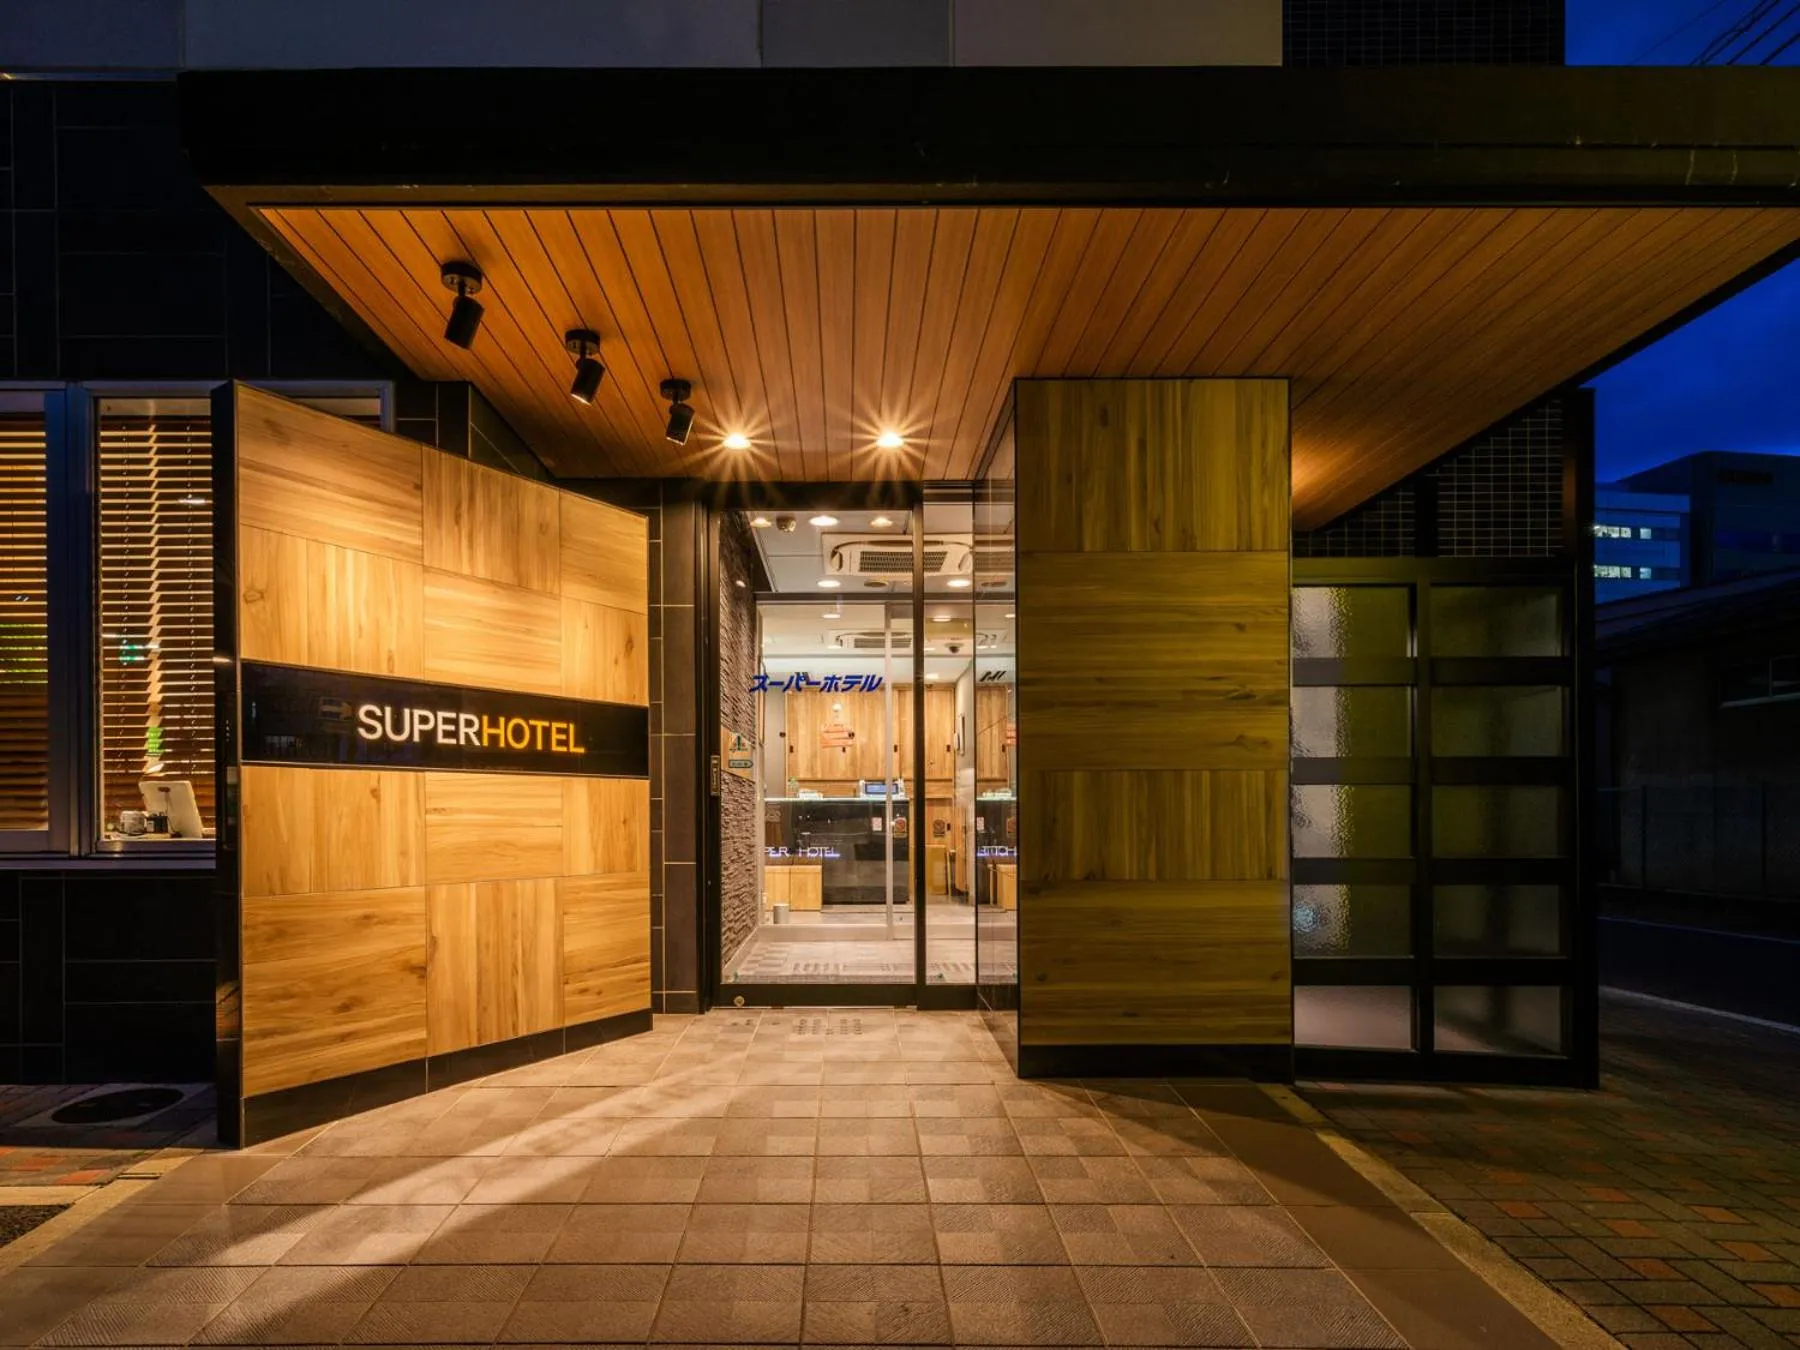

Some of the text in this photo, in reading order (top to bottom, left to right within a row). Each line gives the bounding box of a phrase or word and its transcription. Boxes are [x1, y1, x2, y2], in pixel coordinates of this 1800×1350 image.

[749, 672, 883, 692] スーパーホテル
[798, 846, 840, 858] HOTEL
